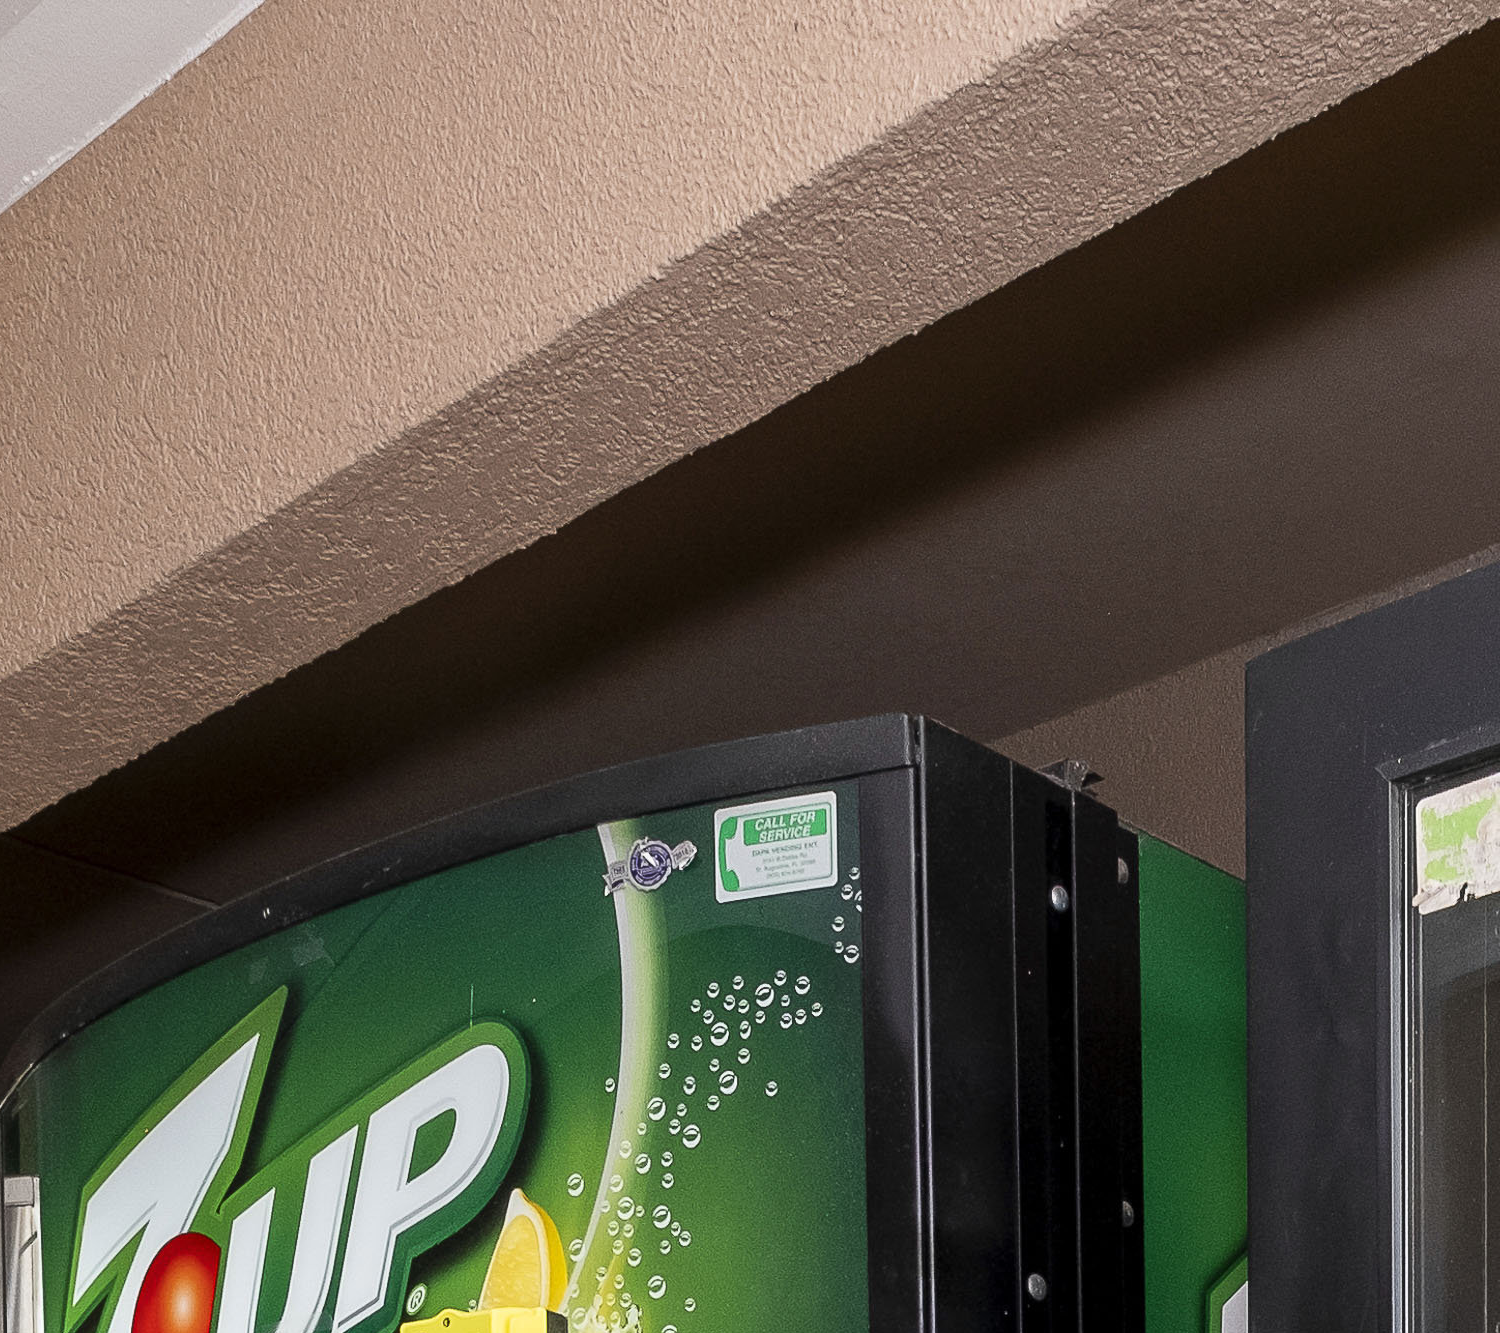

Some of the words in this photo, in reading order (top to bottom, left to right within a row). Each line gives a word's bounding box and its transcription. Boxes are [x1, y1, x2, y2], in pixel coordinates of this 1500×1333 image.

[755, 816, 786, 831] CALL
[790, 811, 816, 825] FOR
[760, 825, 812, 843] SERVICE
